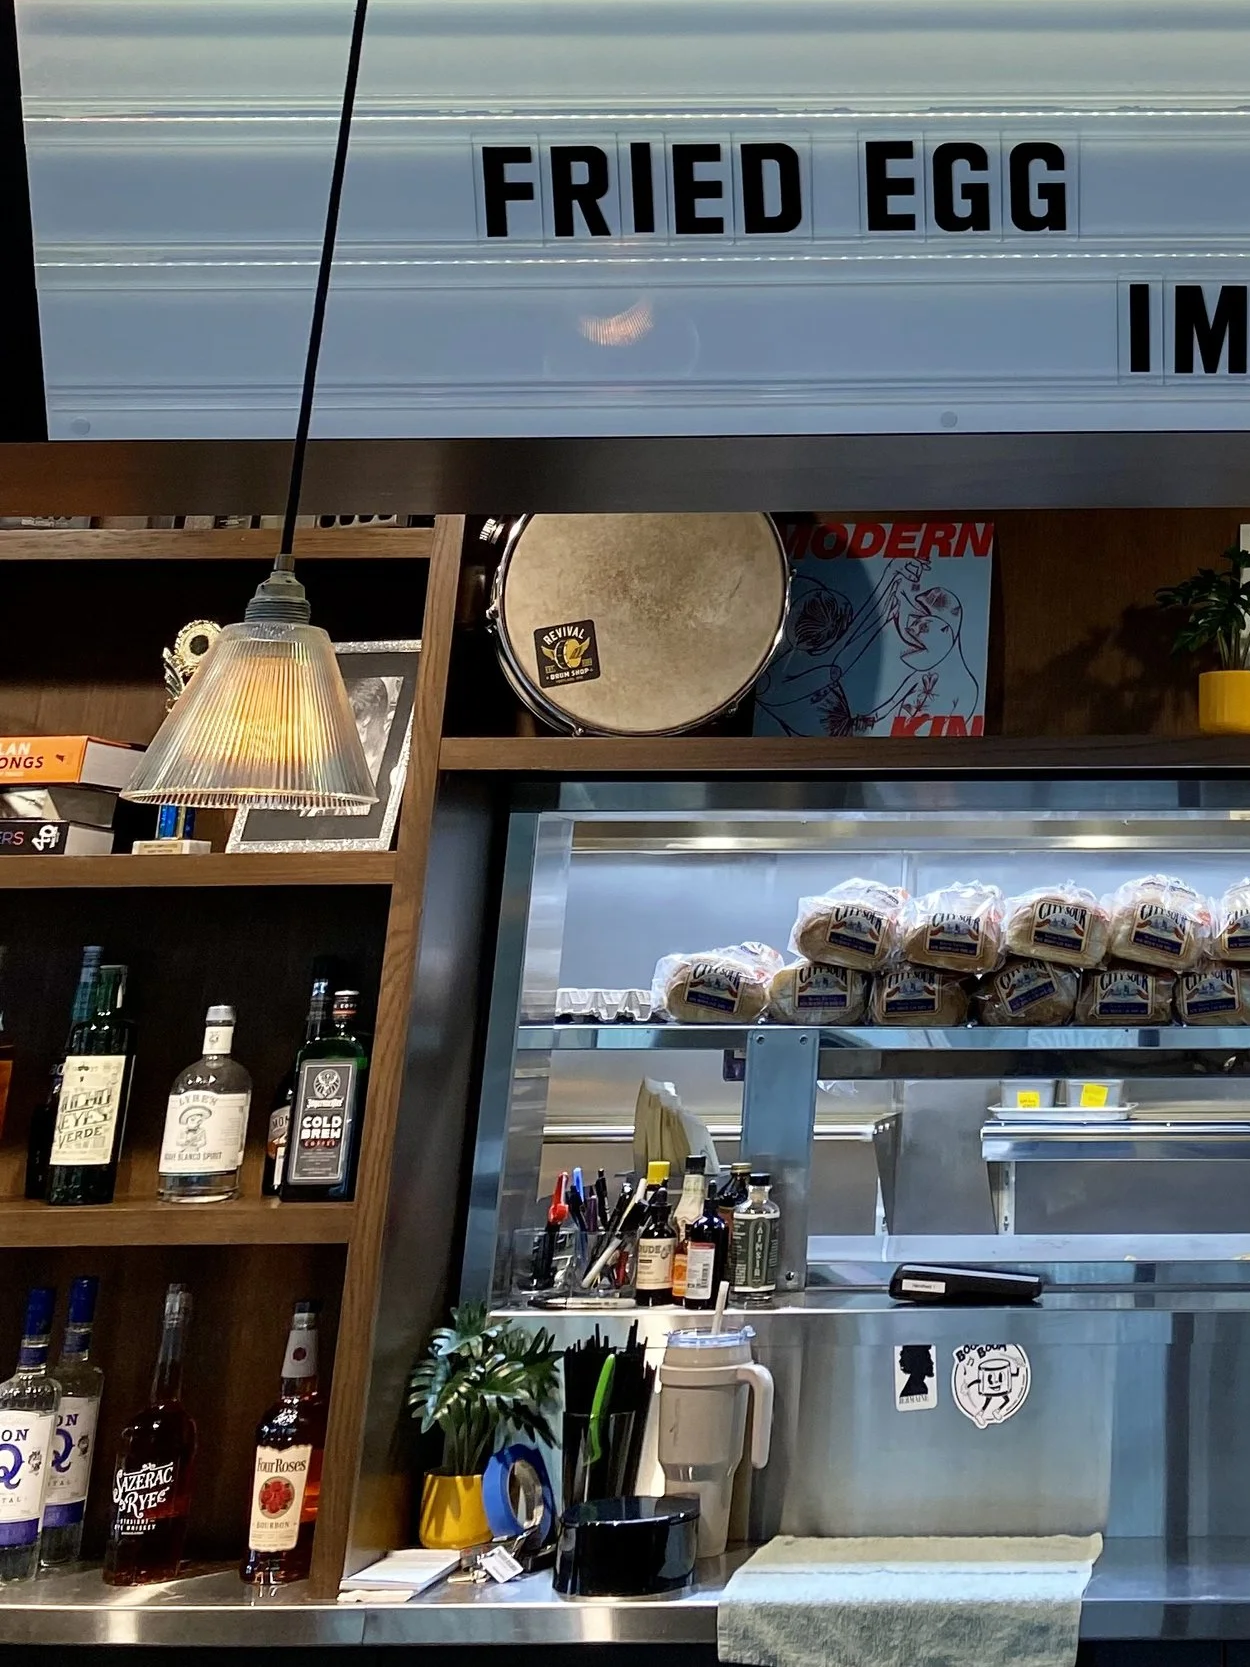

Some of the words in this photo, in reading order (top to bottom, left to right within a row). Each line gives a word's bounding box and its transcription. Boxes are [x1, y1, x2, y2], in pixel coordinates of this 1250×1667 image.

[482, 143, 802, 237] FRIED
[866, 141, 1066, 231] EGG
[1130, 284, 1247, 373] IM
[543, 625, 585, 645] REVIVAL
[550, 670, 571, 681] DRUM
[571, 667, 590, 679] SHOP
[834, 906, 862, 922] CITY
[862, 909, 884, 935] SOUR
[932, 912, 958, 928] CITY
[958, 914, 981, 934] SOUR
[1039, 902, 1064, 920] CITY
[1065, 906, 1088, 928] SOUR
[1140, 904, 1166, 920] CITY
[1166, 909, 1188, 934] SOUR
[1100, 973, 1124, 992] CITY
[1125, 973, 1149, 990] SOUR
[1210, 968, 1234, 989] SOUR
[302, 1115, 343, 1129] COLD
[59, 1126, 103, 1150] VERDE
[300, 1128, 342, 1141] BREW
[956, 1344, 979, 1363] BOO
[257, 1457, 275, 1473] Four
[275, 1458, 307, 1473] Roses
[112, 1466, 174, 1504] SAZERAC
